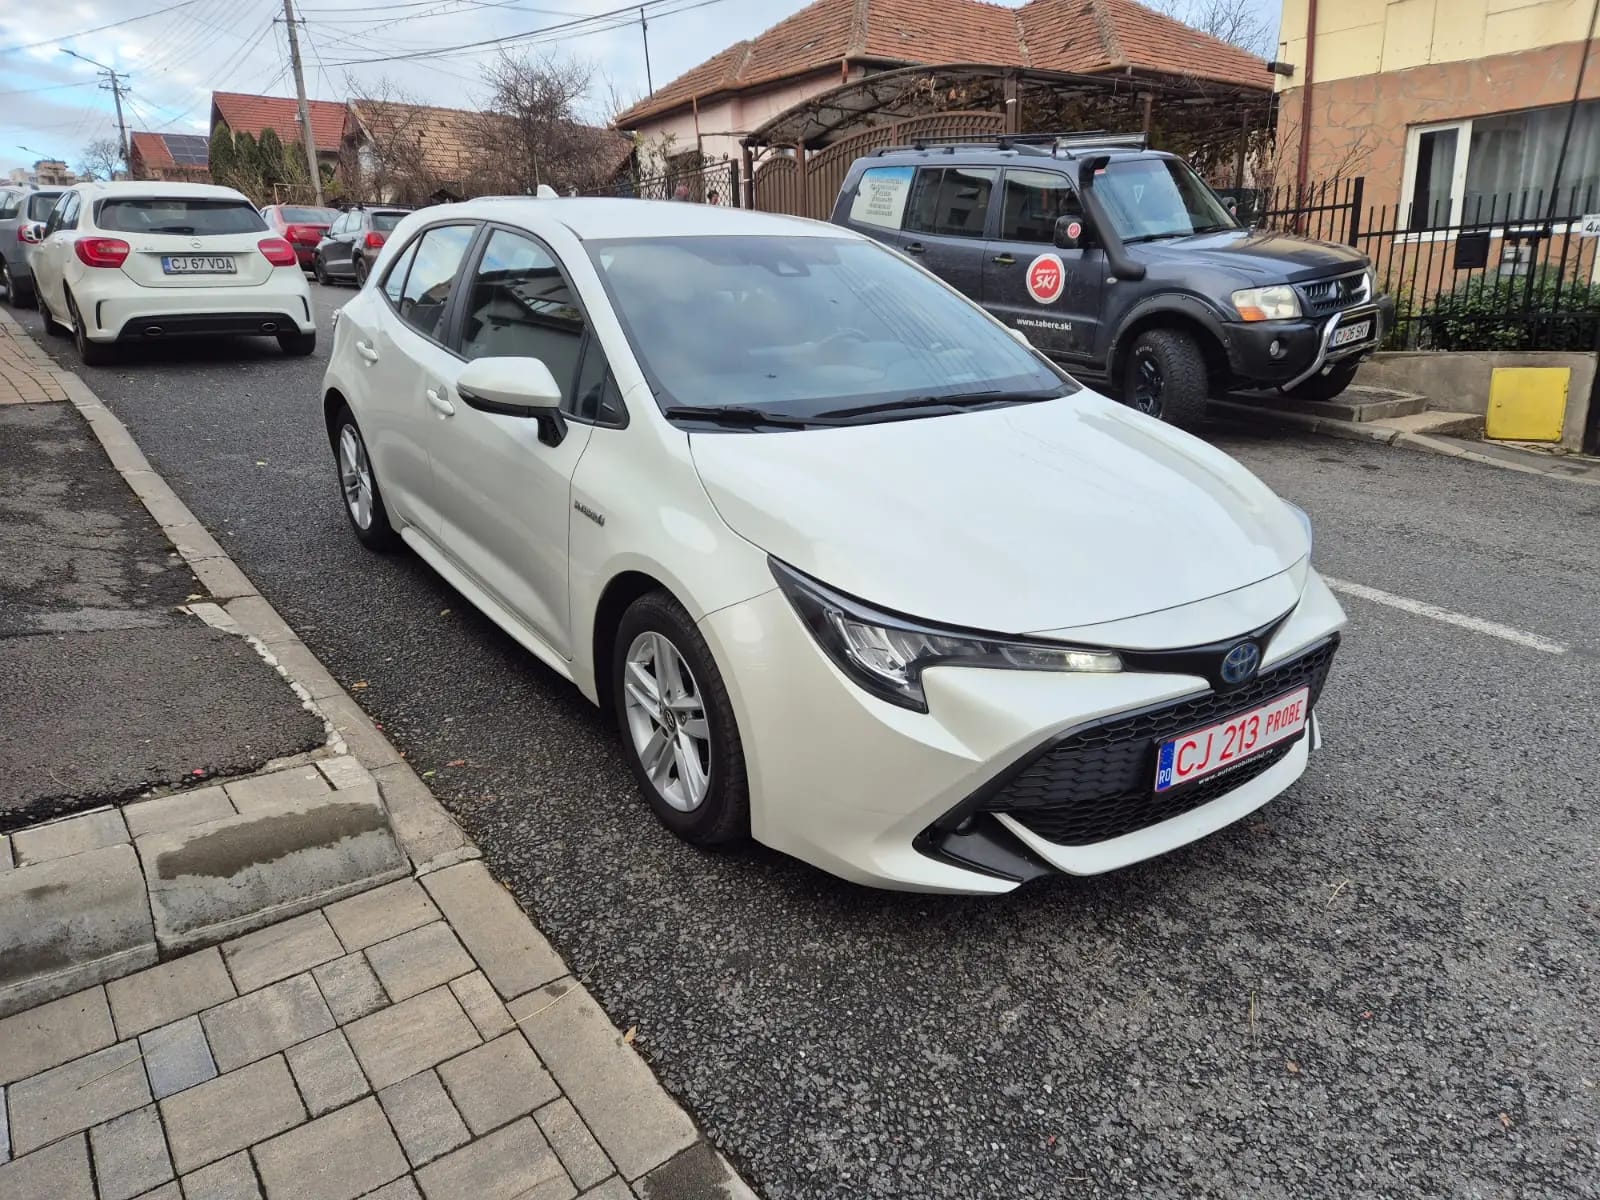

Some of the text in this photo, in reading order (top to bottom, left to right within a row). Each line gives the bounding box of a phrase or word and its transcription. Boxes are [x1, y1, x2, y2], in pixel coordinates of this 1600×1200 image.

[171, 258, 188, 270] CJ
[191, 258, 205, 270] 67
[207, 258, 233, 270] VDA
[1033, 274, 1057, 290] SKI
[1016, 319, 1072, 330] www.tabere.ski
[1176, 700, 1303, 776] CJ 213 PROBE
[1158, 768, 1172, 785] RO
